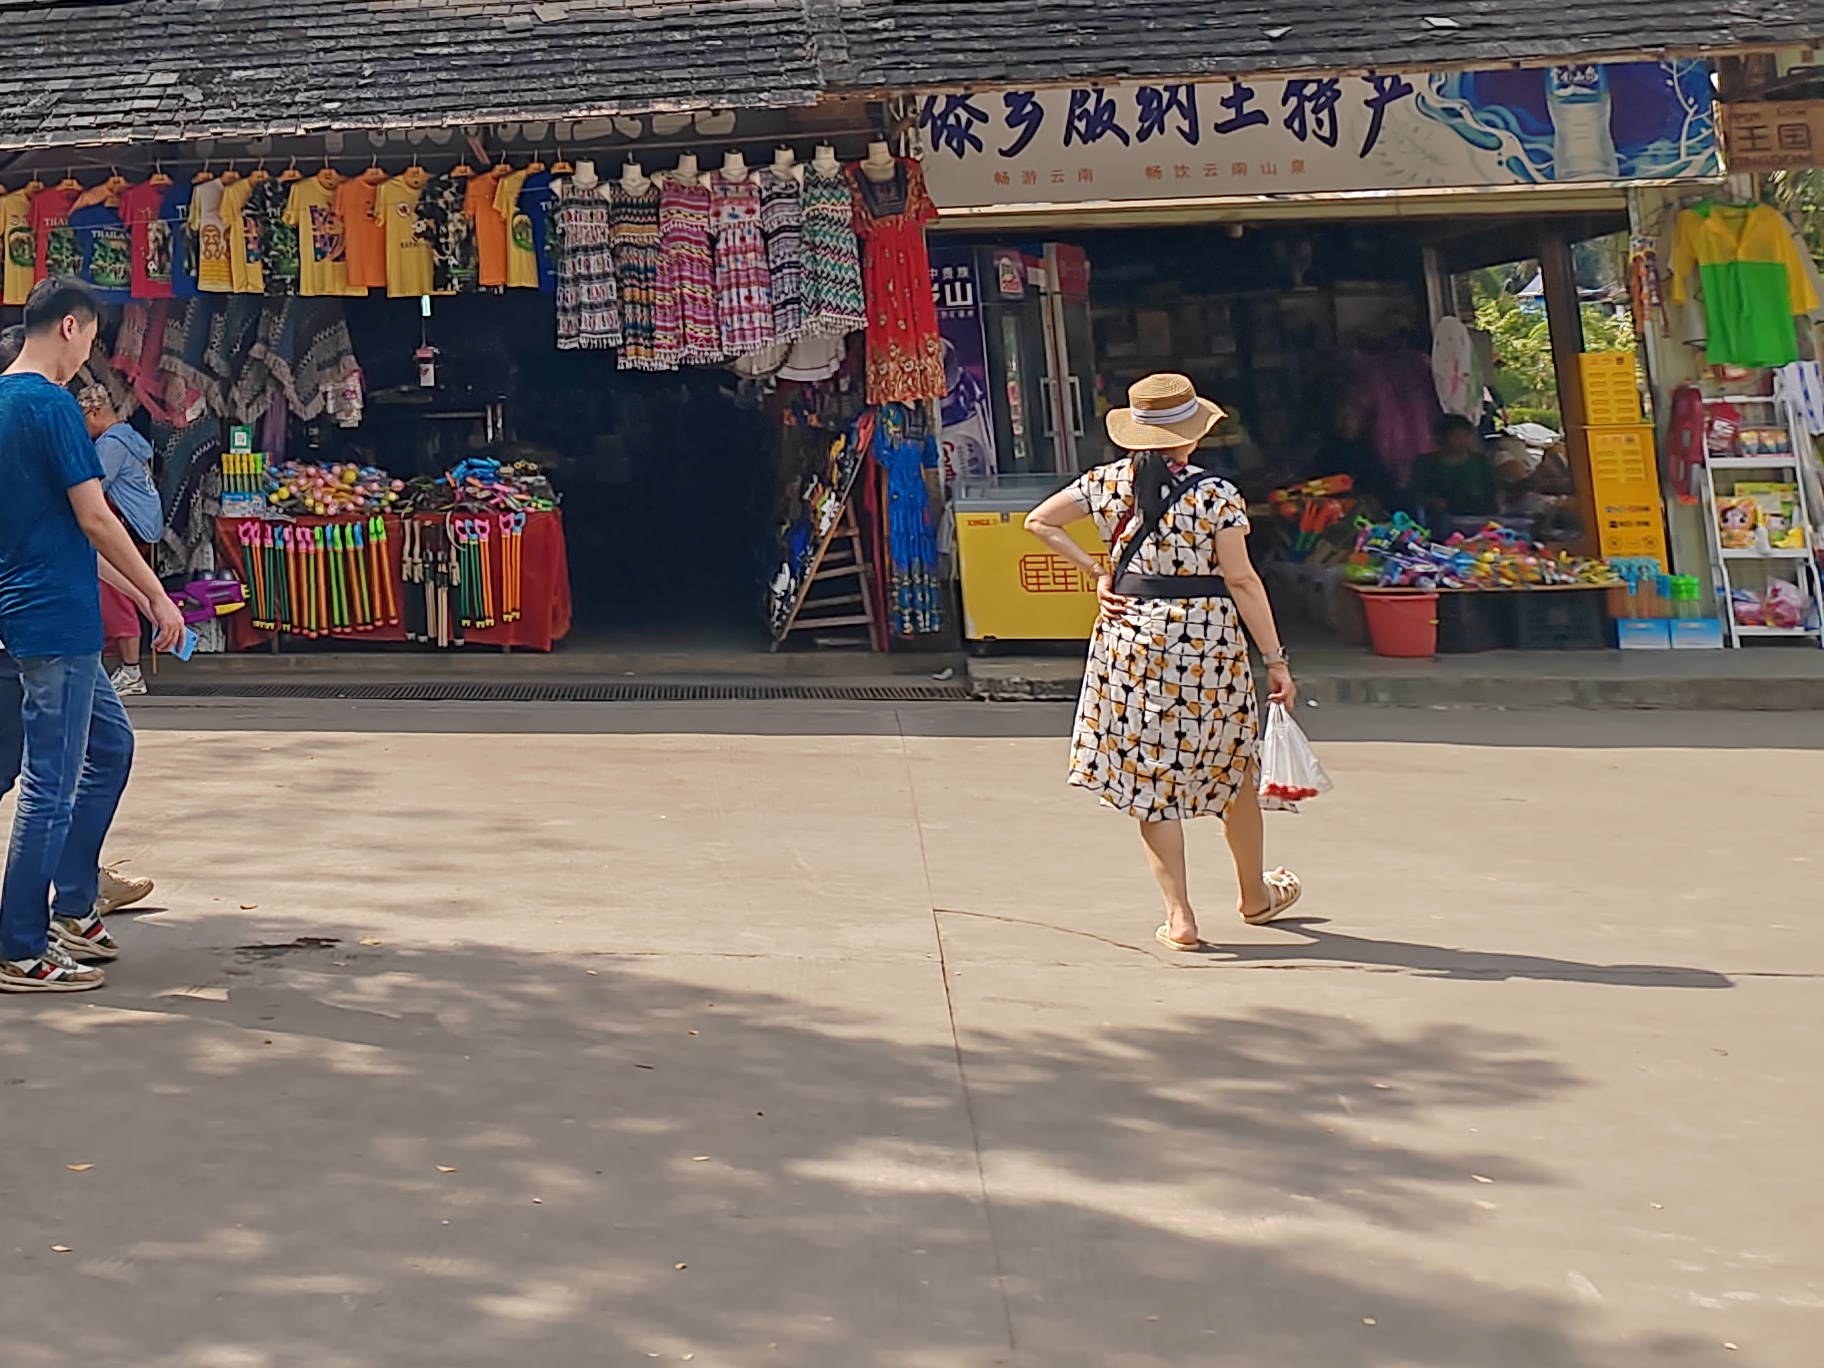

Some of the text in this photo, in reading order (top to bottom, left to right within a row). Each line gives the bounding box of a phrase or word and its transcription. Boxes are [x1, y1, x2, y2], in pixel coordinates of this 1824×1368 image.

[993, 158, 1306, 186] 畅游云南 畅饮云南山泉
